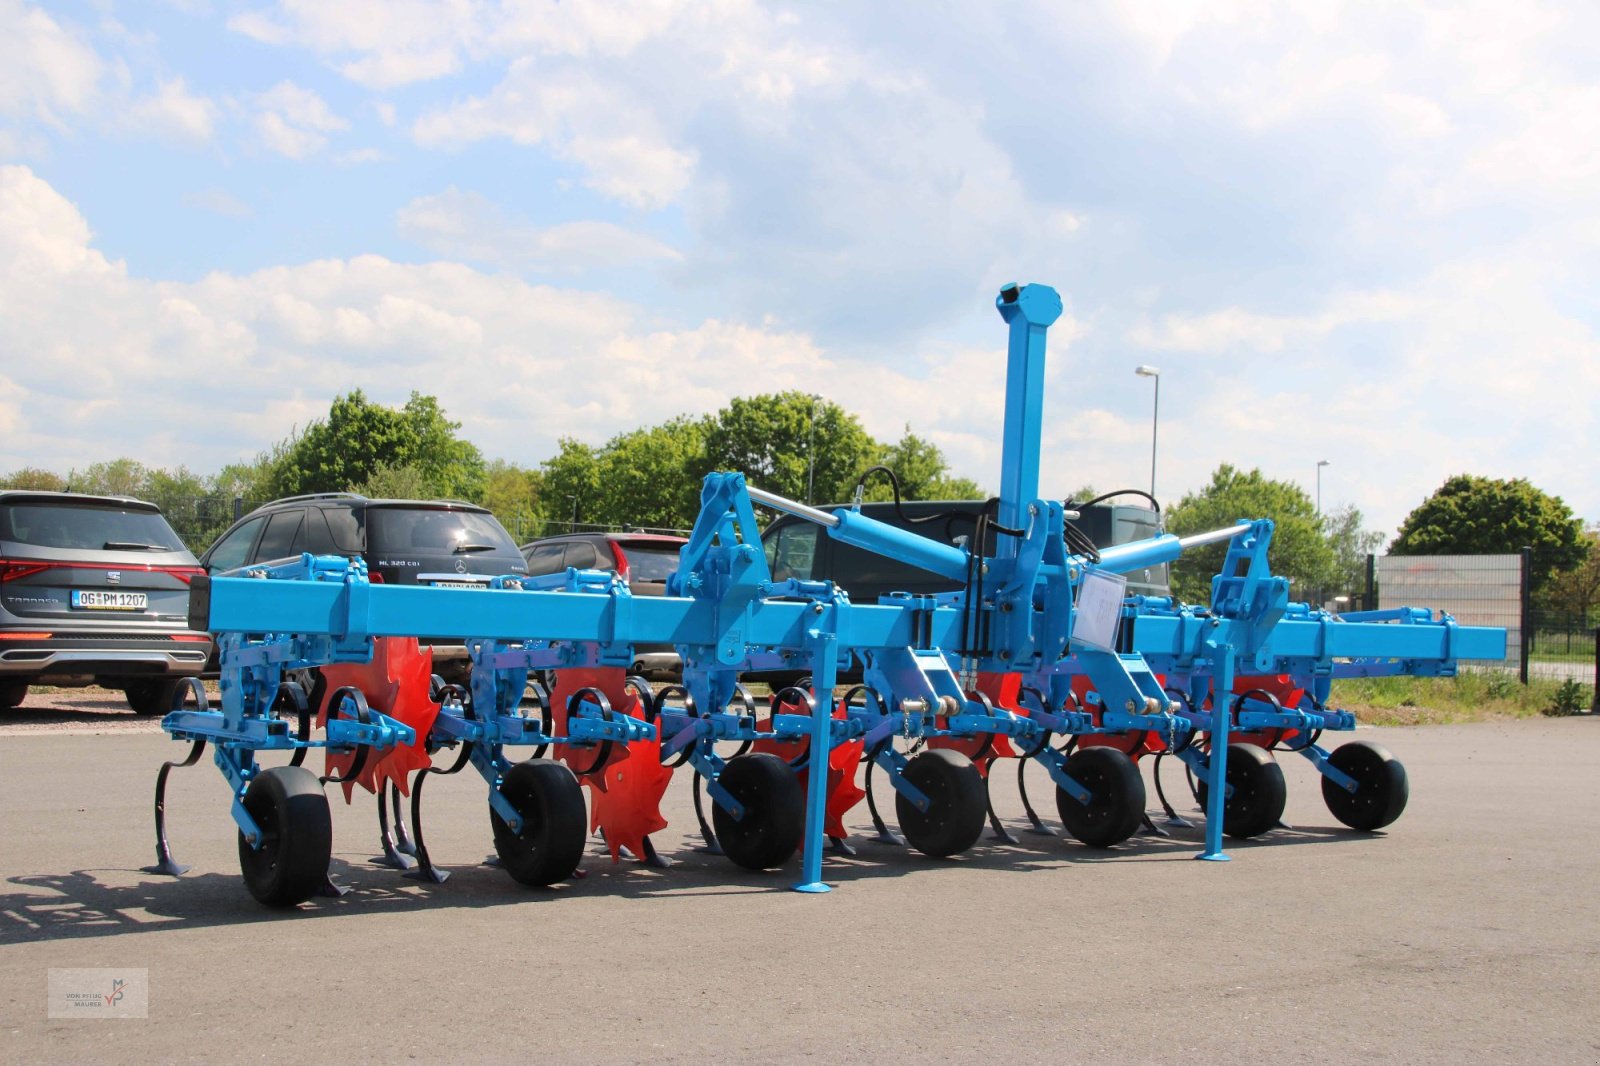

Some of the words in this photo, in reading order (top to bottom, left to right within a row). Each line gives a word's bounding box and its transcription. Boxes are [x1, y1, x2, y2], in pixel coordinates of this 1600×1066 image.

[81, 593, 95, 604] OG
[103, 593, 117, 605] PM
[119, 594, 146, 606] 1207
